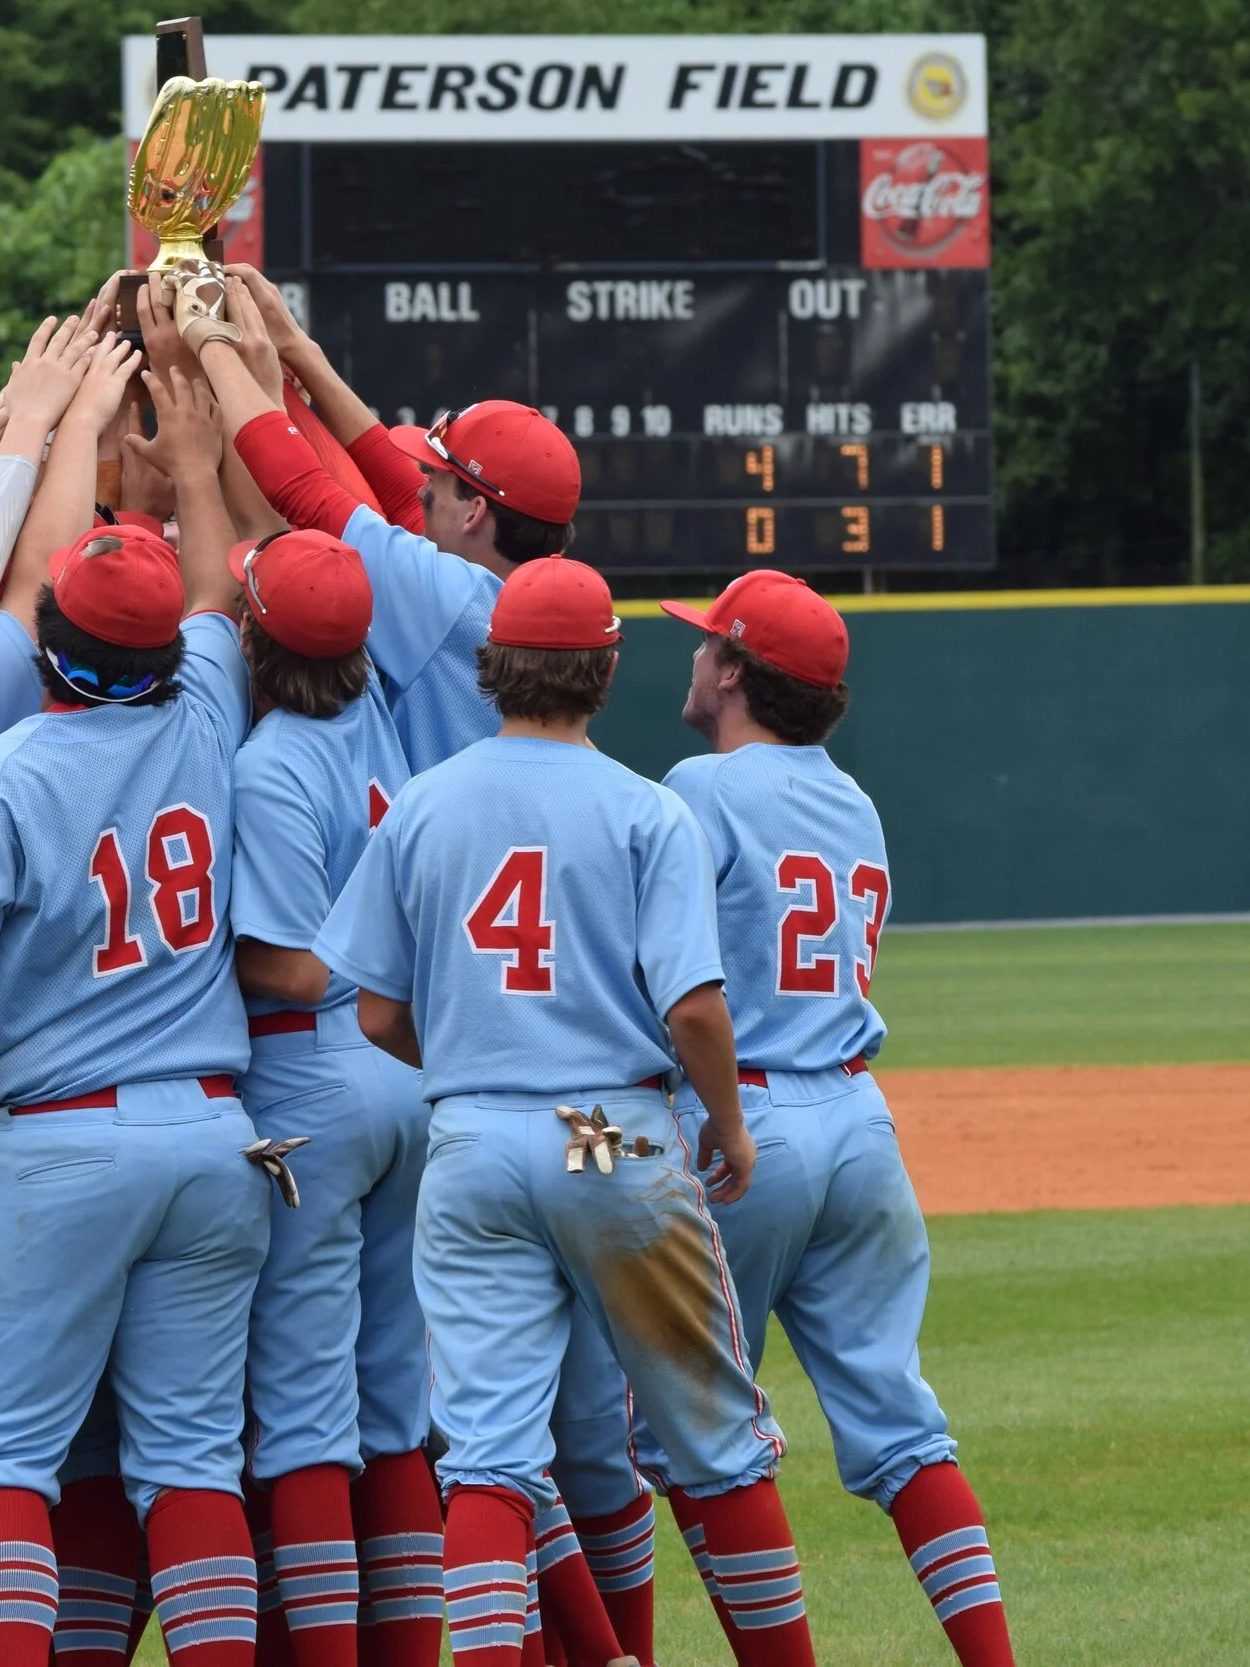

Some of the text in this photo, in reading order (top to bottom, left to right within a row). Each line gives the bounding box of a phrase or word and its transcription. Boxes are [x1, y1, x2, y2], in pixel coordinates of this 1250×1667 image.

[247, 63, 626, 112] PATERSON
[667, 63, 879, 110] FIELD
[384, 279, 866, 322] BALL STRIKE OUT
[574, 405, 594, 437] 8
[611, 405, 630, 437] 9
[641, 405, 671, 437] 10
[703, 404, 783, 436] RUNS
[806, 402, 872, 435] HITS
[901, 402, 956, 434] ERR
[745, 444, 943, 491] 4 7 1
[746, 505, 943, 553] 0 3 1
[89, 802, 215, 978] 18
[463, 846, 556, 996] 4
[775, 850, 891, 999] 23
